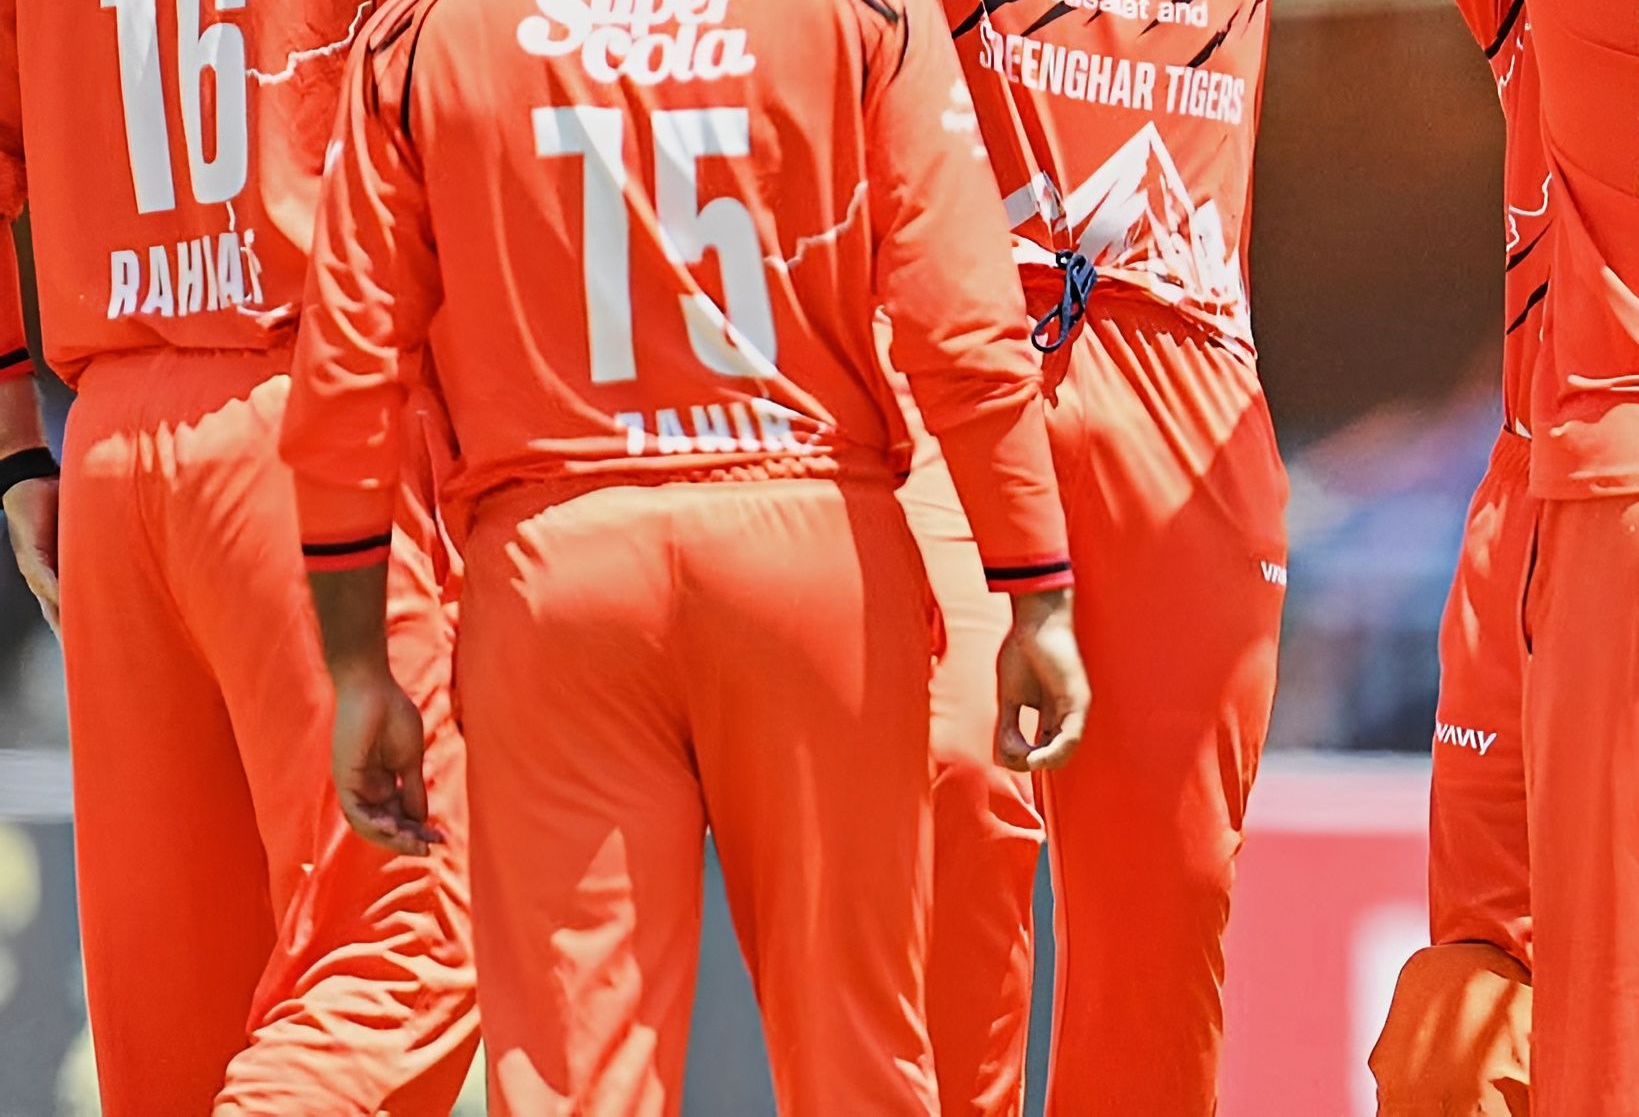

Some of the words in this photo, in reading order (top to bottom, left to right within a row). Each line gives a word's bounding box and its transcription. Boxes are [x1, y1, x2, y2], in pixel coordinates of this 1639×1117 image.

[1156, 0, 1208, 28] and
[1164, 64, 1246, 126] TIGERS
[531, 106, 777, 382] 75
